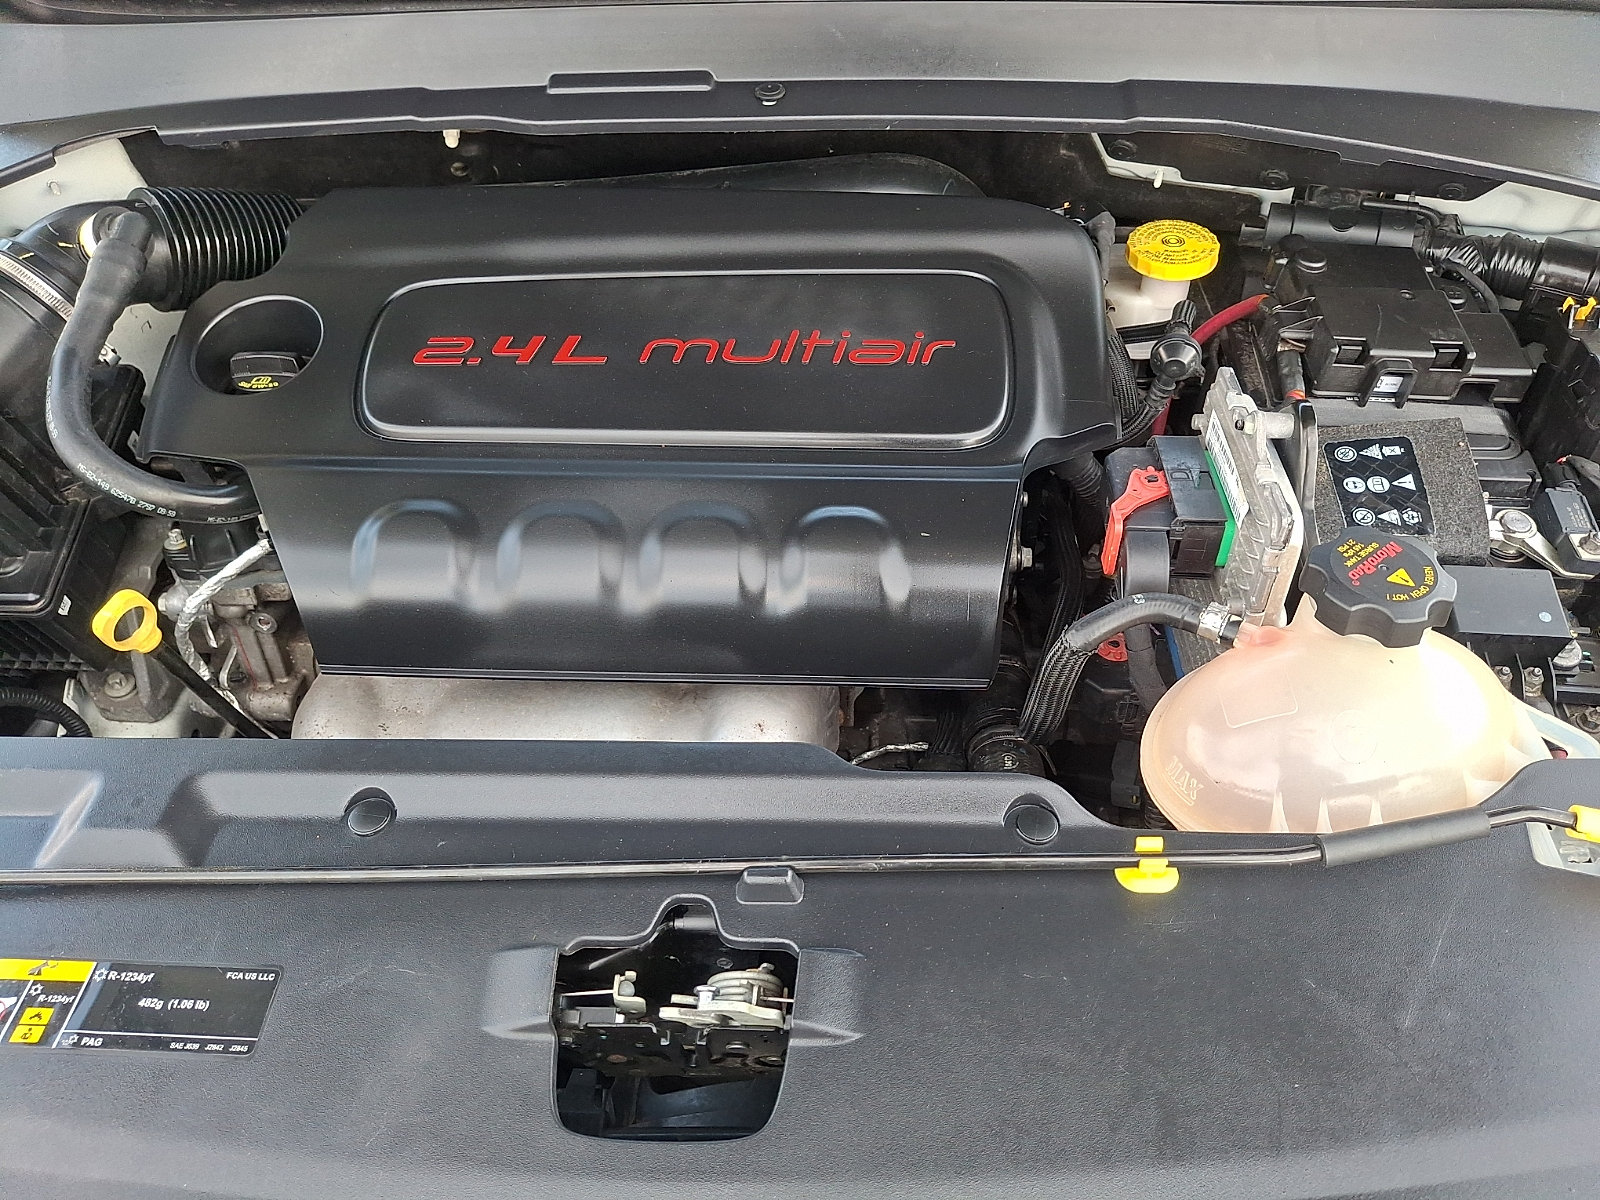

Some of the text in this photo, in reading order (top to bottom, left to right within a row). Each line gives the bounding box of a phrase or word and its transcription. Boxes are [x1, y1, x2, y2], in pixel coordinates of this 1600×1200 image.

[413, 330, 956, 365] 2.4L multiair
[1344, 542, 1380, 568] SURGE TANK
[1422, 566, 1435, 586] NEVER
[1410, 585, 1430, 599] OPEN
[1165, 755, 1204, 800] MAX
[107, 970, 156, 984] R-1234yf
[226, 971, 276, 981] FCA US LLC
[36, 994, 76, 1005] R-1234yf
[138, 998, 210, 1011] 482g (1.06 lb)
[80, 1036, 104, 1047] PAG
[169, 1041, 185, 1050] SAE
